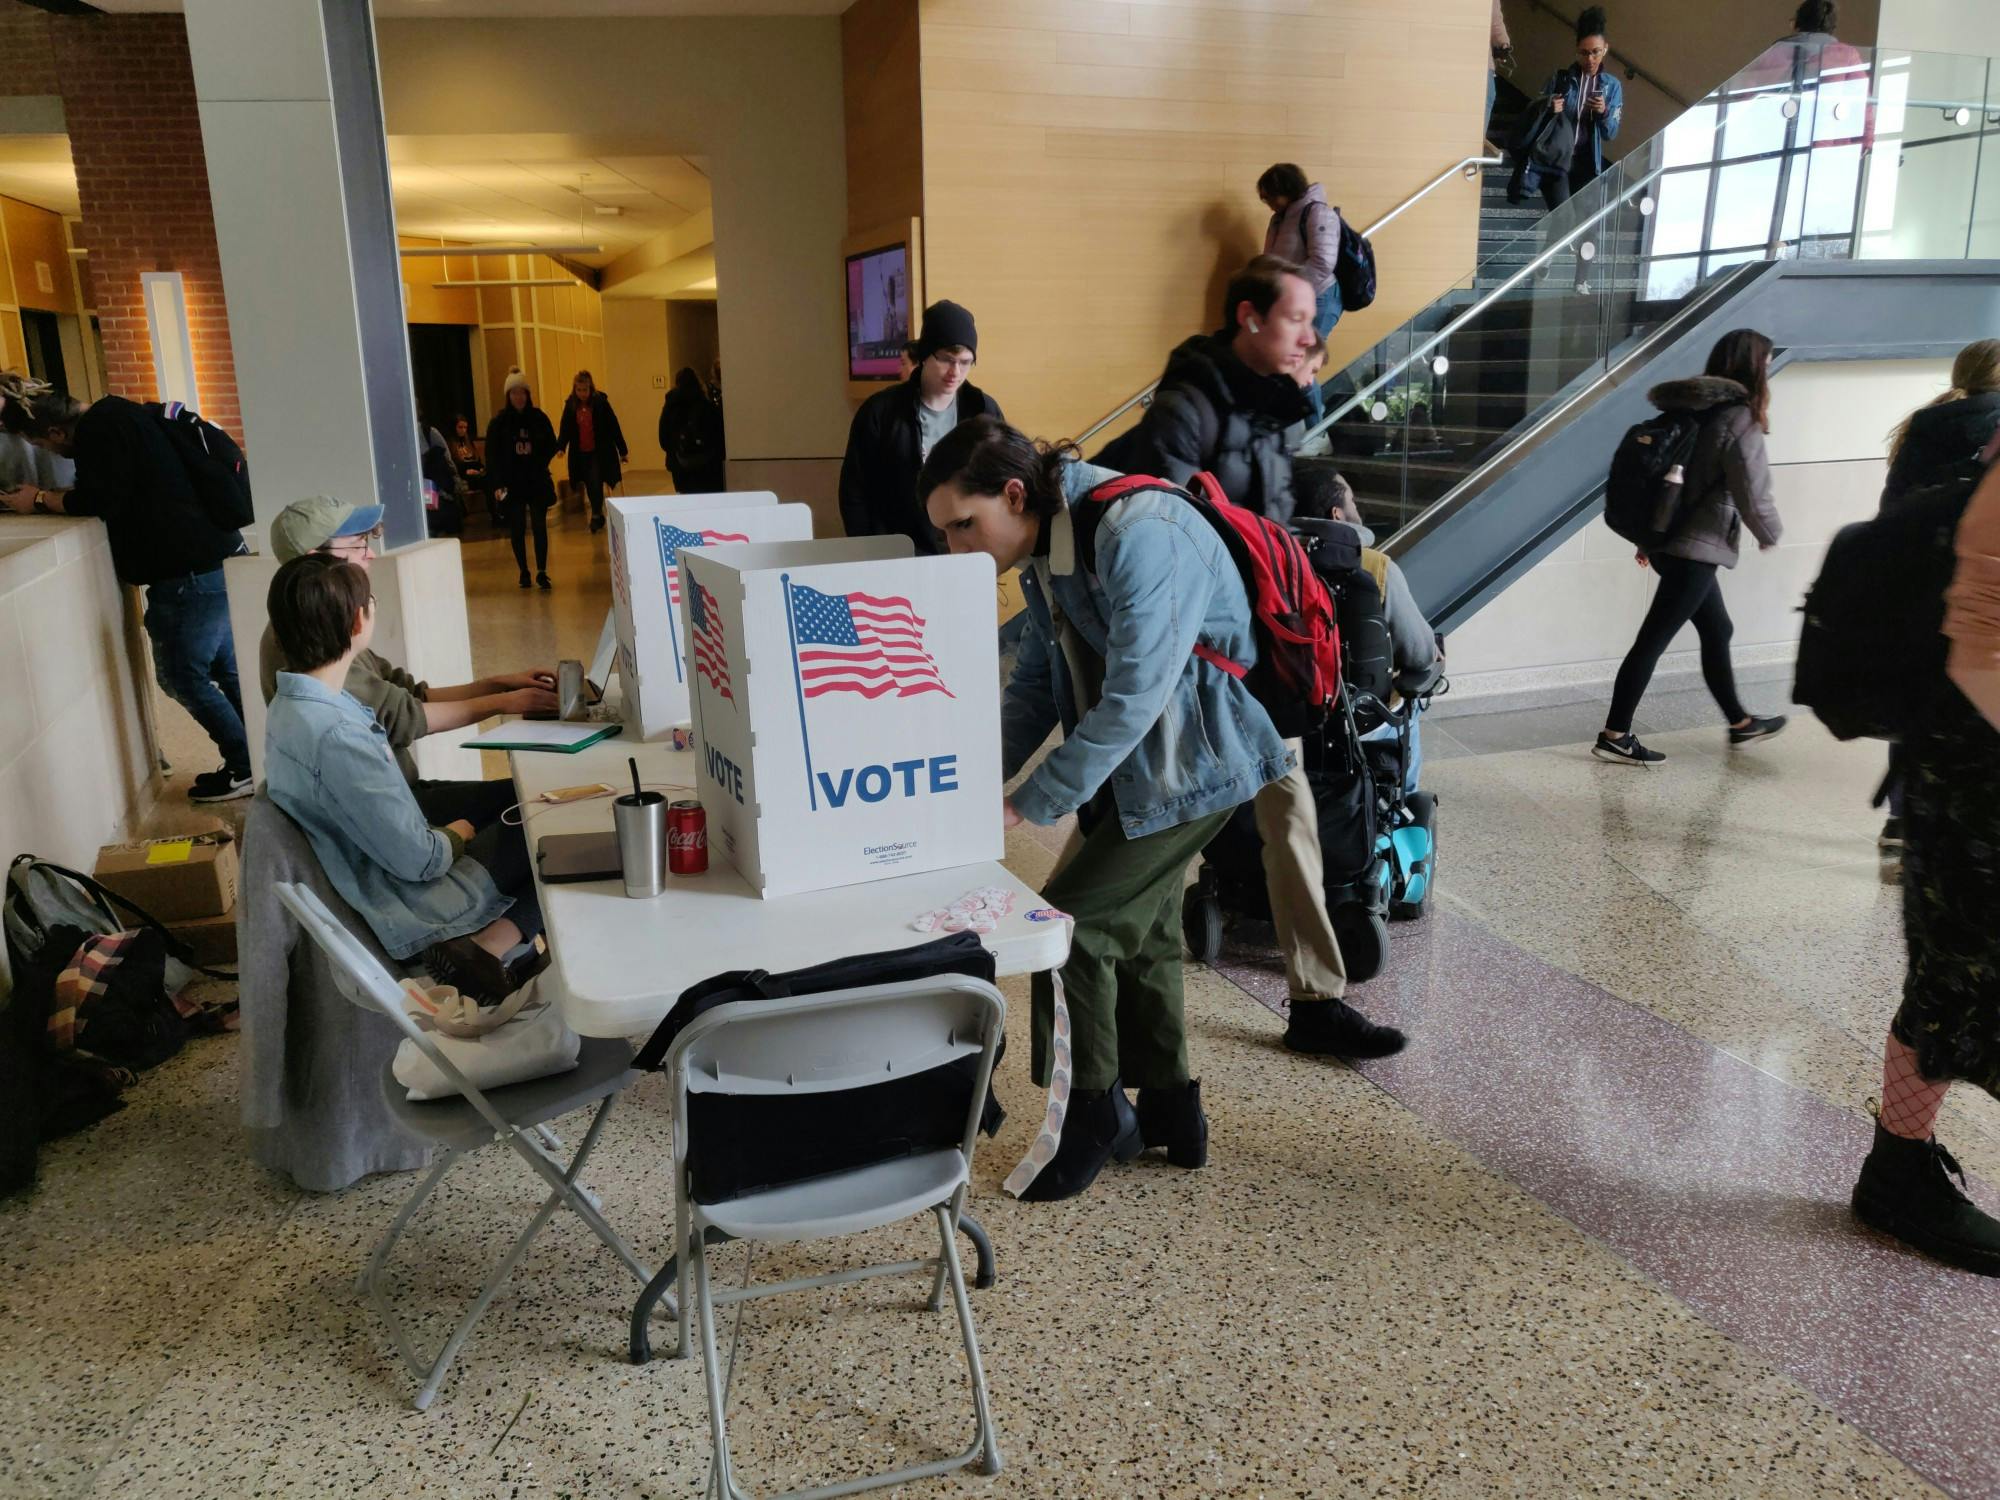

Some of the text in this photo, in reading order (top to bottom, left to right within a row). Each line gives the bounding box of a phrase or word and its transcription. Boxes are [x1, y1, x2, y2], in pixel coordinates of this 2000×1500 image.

[705, 742, 744, 805] VOTE
[816, 754, 959, 808] VOTE
[863, 841, 918, 855] ElectionSource
